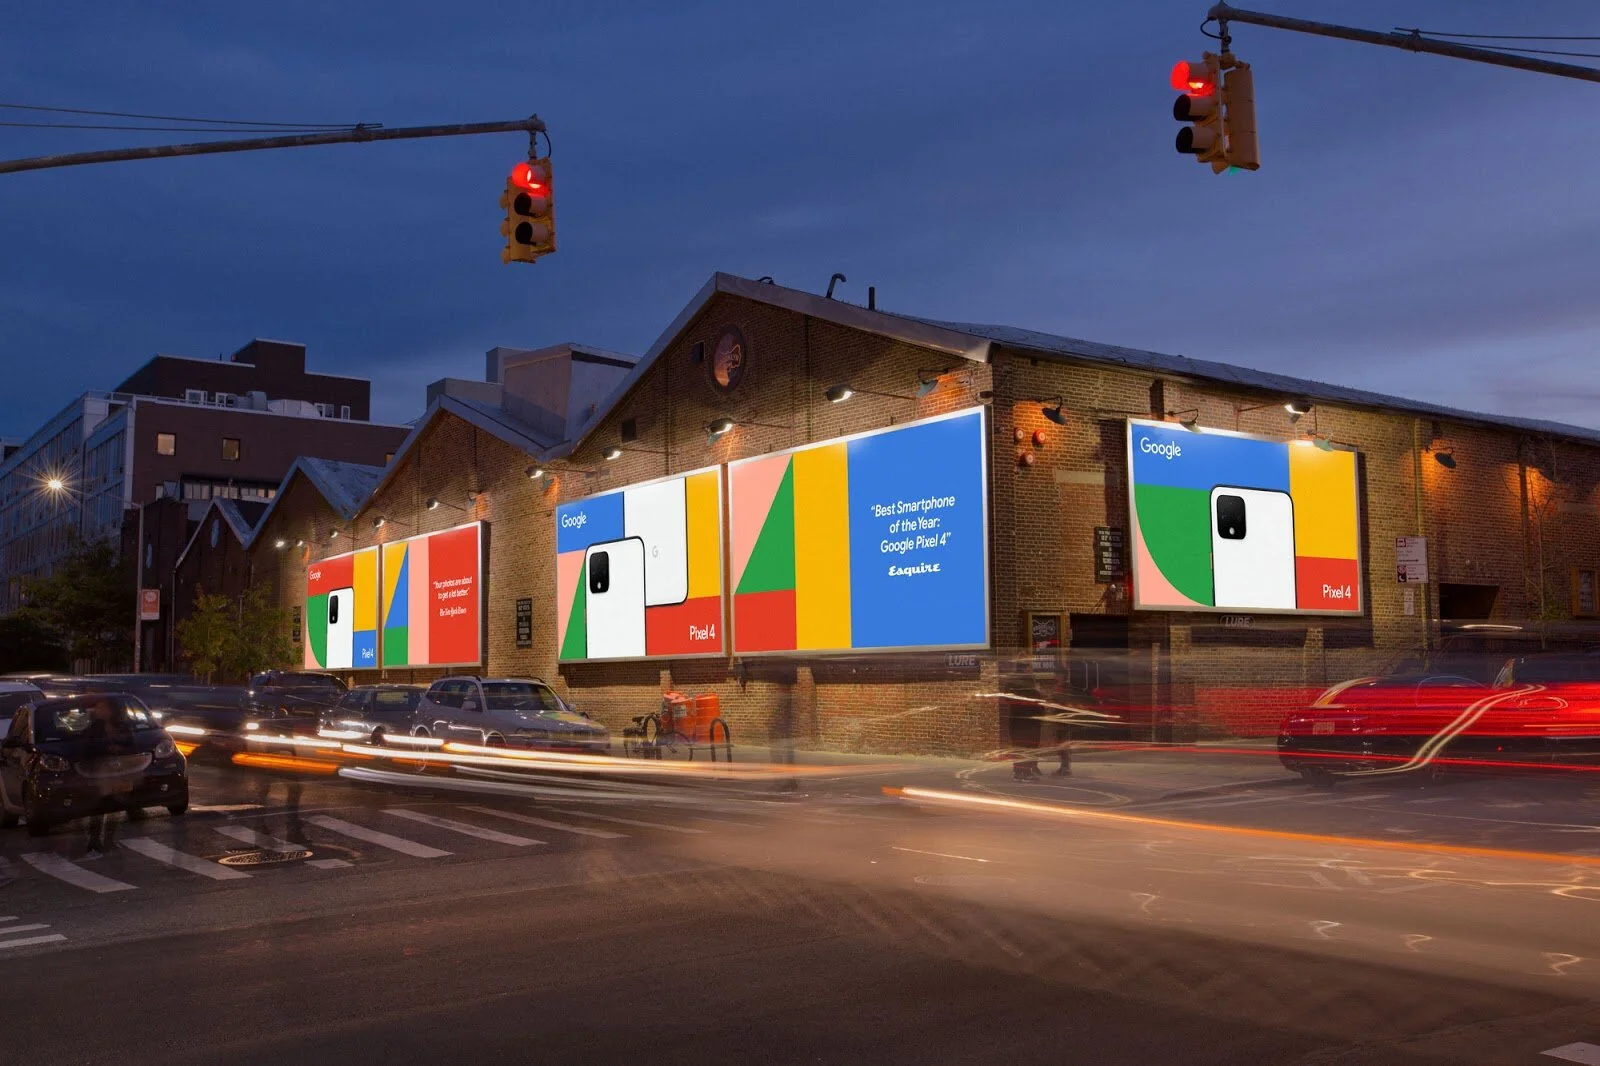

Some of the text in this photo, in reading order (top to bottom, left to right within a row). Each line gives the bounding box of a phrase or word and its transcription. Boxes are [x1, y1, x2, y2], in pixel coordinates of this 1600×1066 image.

[1140, 436, 1182, 460] Google
[871, 496, 956, 517] “Best Smartphone
[561, 511, 587, 529] Google
[889, 516, 941, 534] of the Year:
[880, 537, 915, 555] Google
[915, 533, 939, 550] Pixel
[309, 570, 322, 581] Google
[888, 562, 942, 577] Esquire
[1322, 583, 1352, 599] Pixel 4
[1224, 616, 1251, 628] LURE
[689, 623, 716, 641] Pixel 4
[948, 654, 977, 666] LURE
